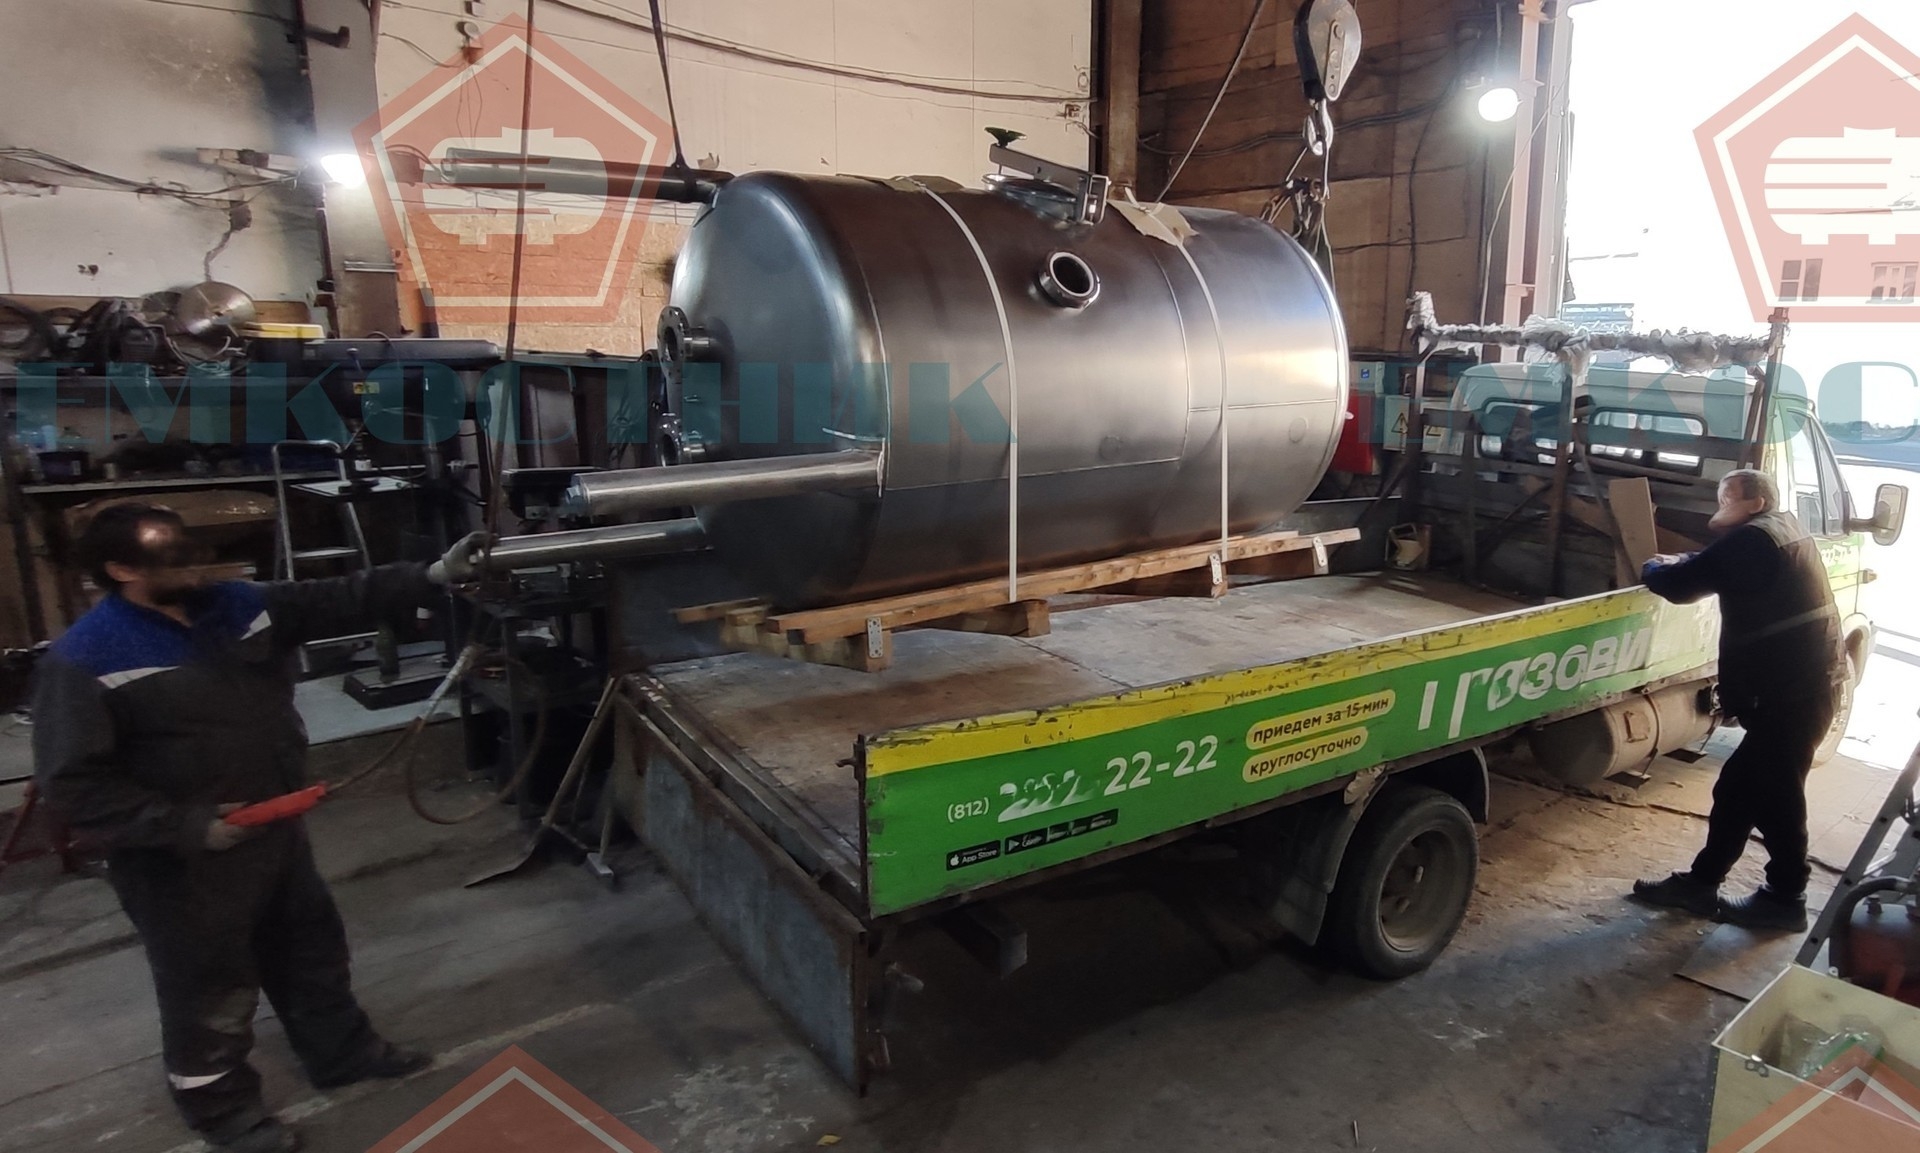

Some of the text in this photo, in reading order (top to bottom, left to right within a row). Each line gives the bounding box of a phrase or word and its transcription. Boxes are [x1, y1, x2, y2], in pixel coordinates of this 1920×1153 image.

[1252, 714, 1322, 744] приедем
[1325, 710, 1342, 724] за
[1250, 734, 1362, 777] круглосуточно
[947, 796, 990, 823] (812)
[1103, 734, 1218, 797] 22-22
[962, 855, 977, 865] App
[978, 849, 998, 860] Store
